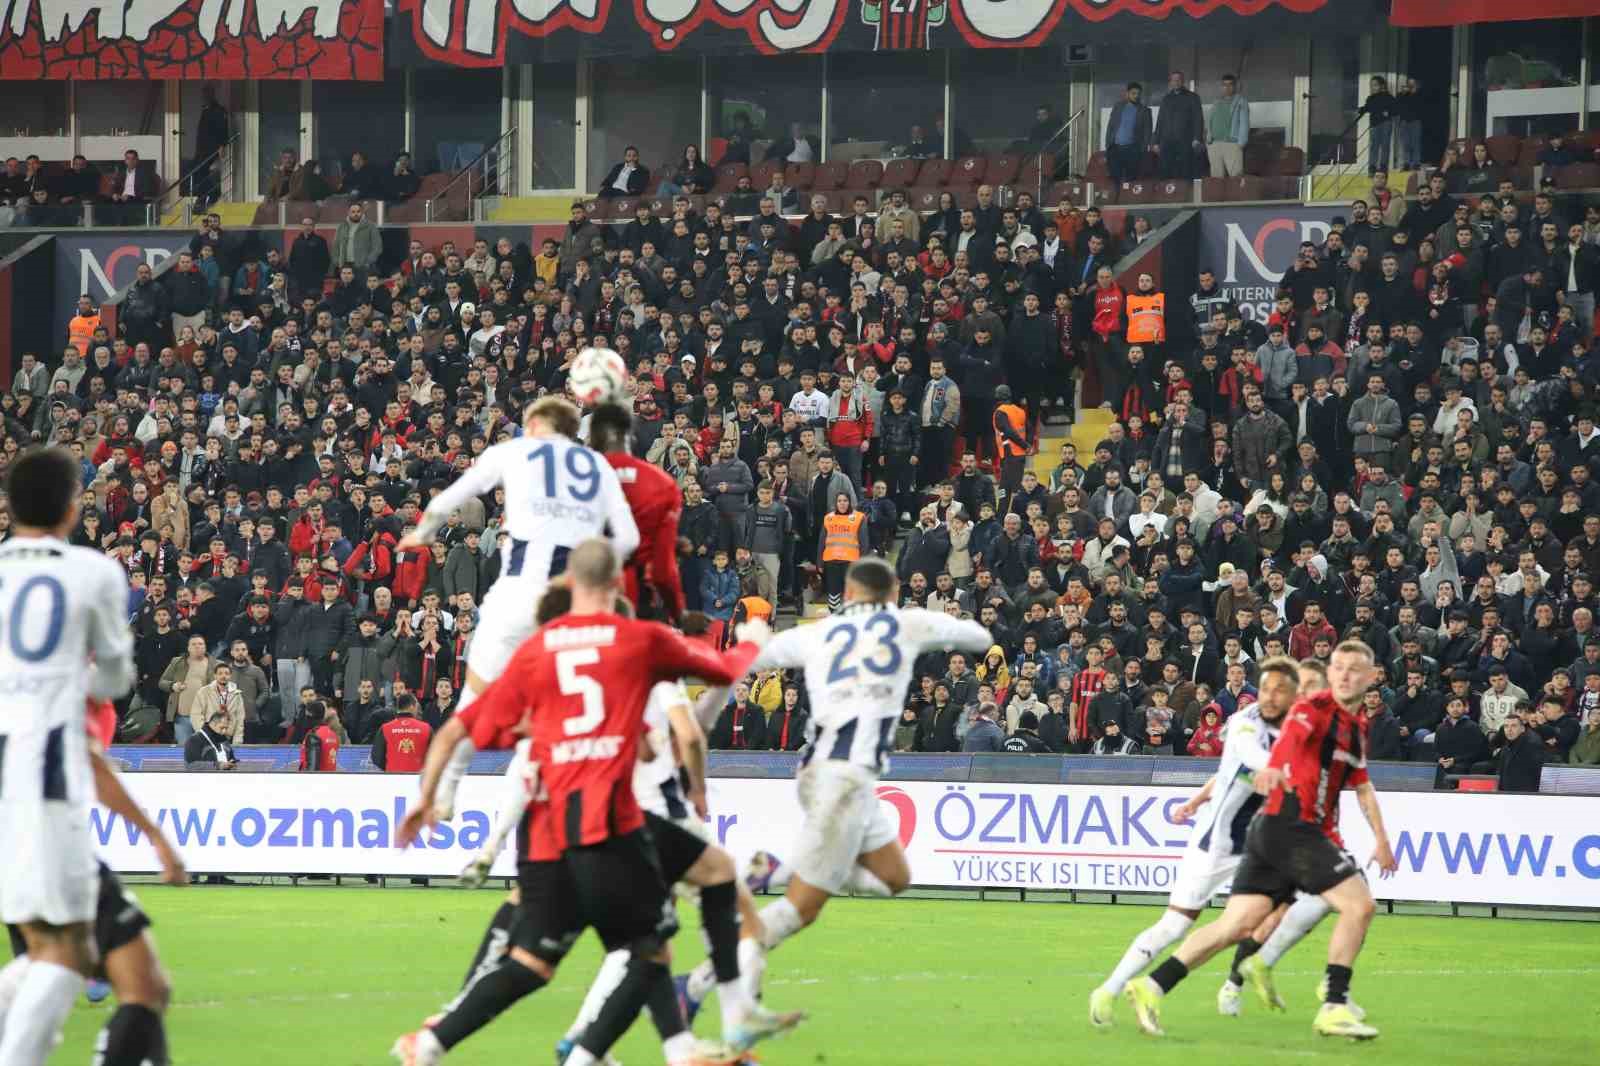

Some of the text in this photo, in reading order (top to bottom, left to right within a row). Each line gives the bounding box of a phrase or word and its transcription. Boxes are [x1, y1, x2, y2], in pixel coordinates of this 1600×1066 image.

[527, 443, 602, 502] 19
[0, 574, 67, 662] 0
[825, 612, 902, 685] 23
[555, 648, 606, 737] 5
[89, 796, 500, 850] www.ozmaksa
[953, 856, 1043, 883] YÜKSEK
